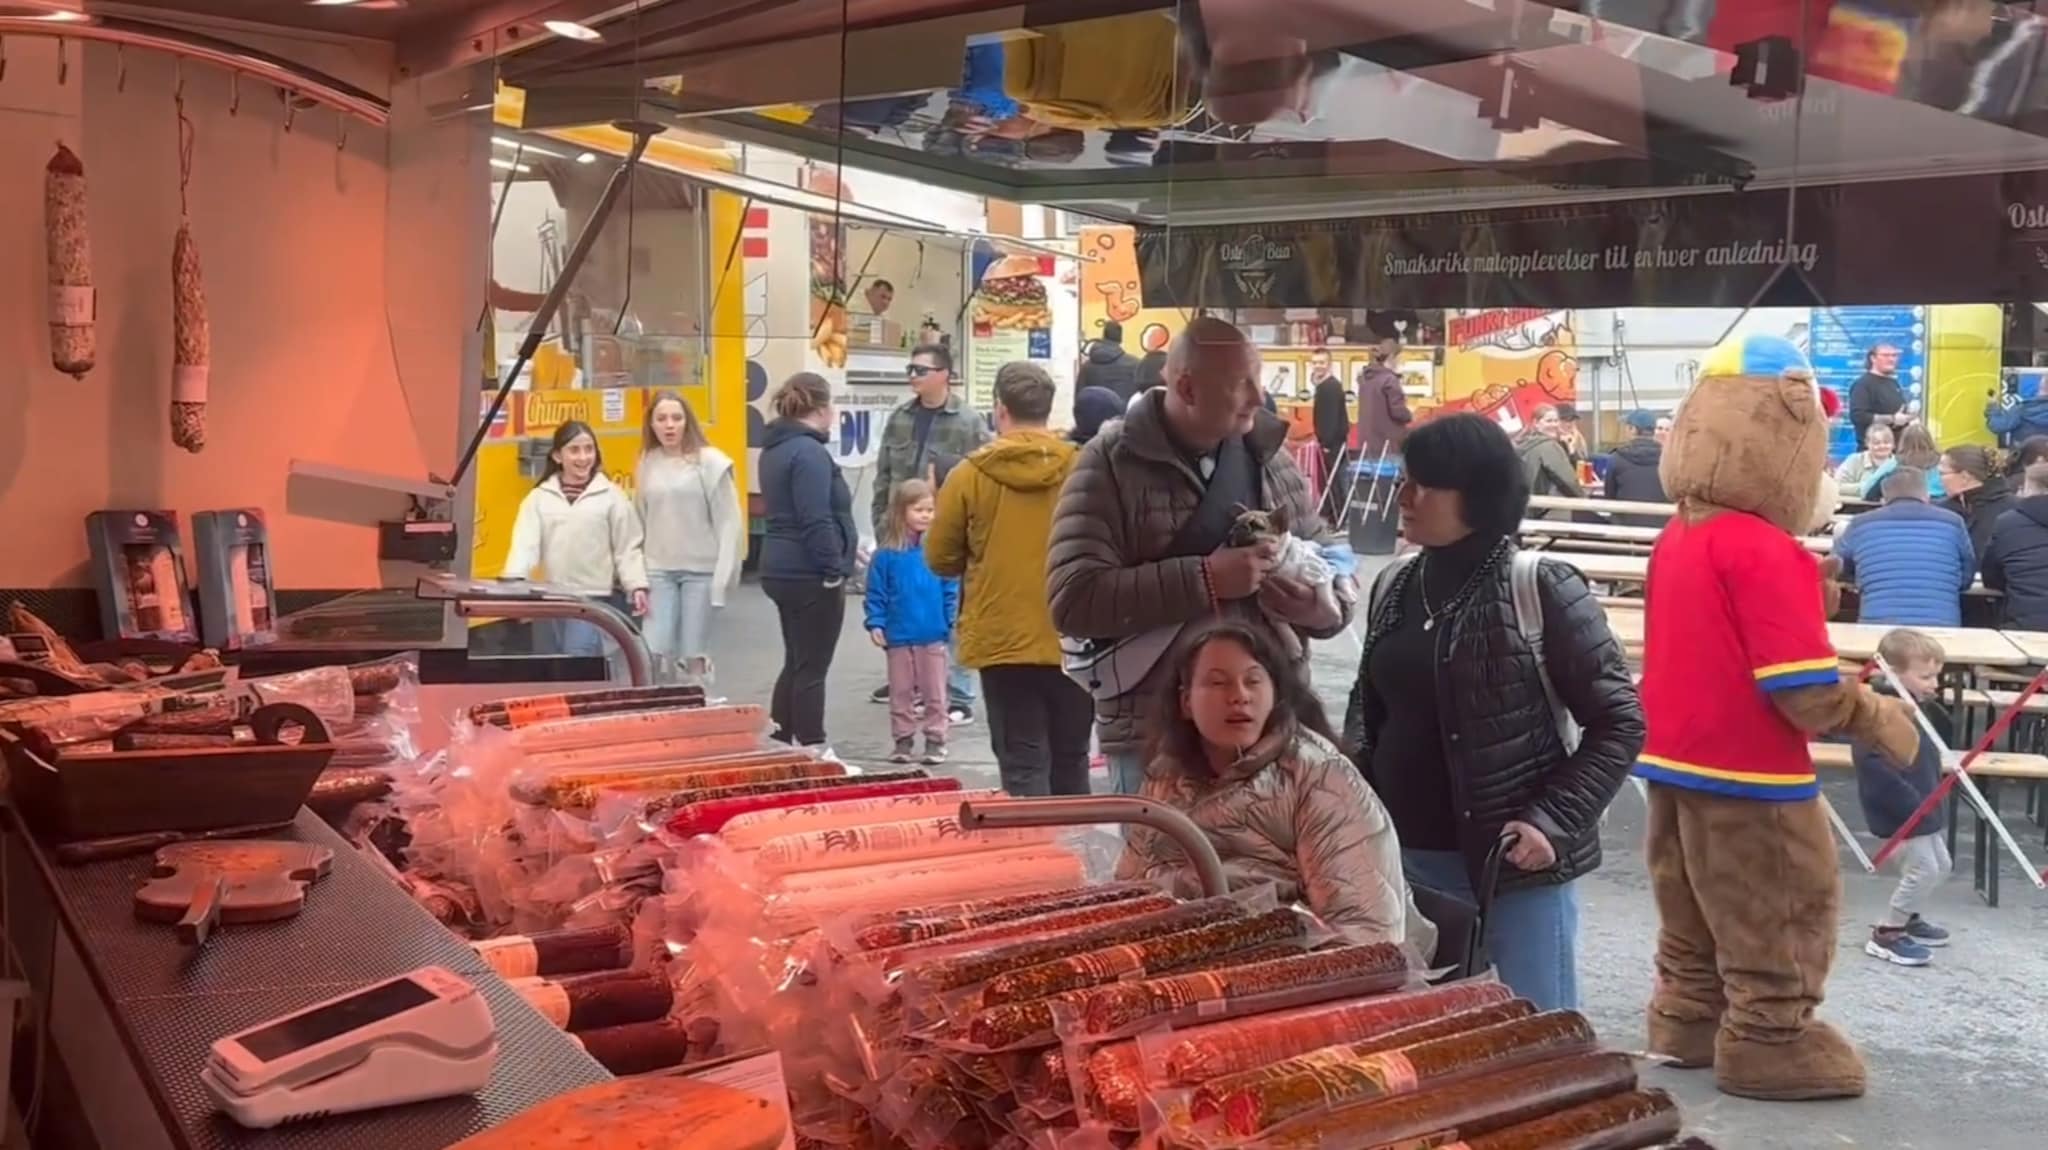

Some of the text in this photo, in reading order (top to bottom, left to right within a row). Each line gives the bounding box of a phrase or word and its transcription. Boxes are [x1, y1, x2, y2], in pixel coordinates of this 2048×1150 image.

[2008, 202, 2048, 228] Ost
[1220, 241, 1291, 261] Oste Bua
[1383, 239, 1818, 278] Smaksrike matopplevelser til en hver anledning
[840, 410, 870, 457] DU
